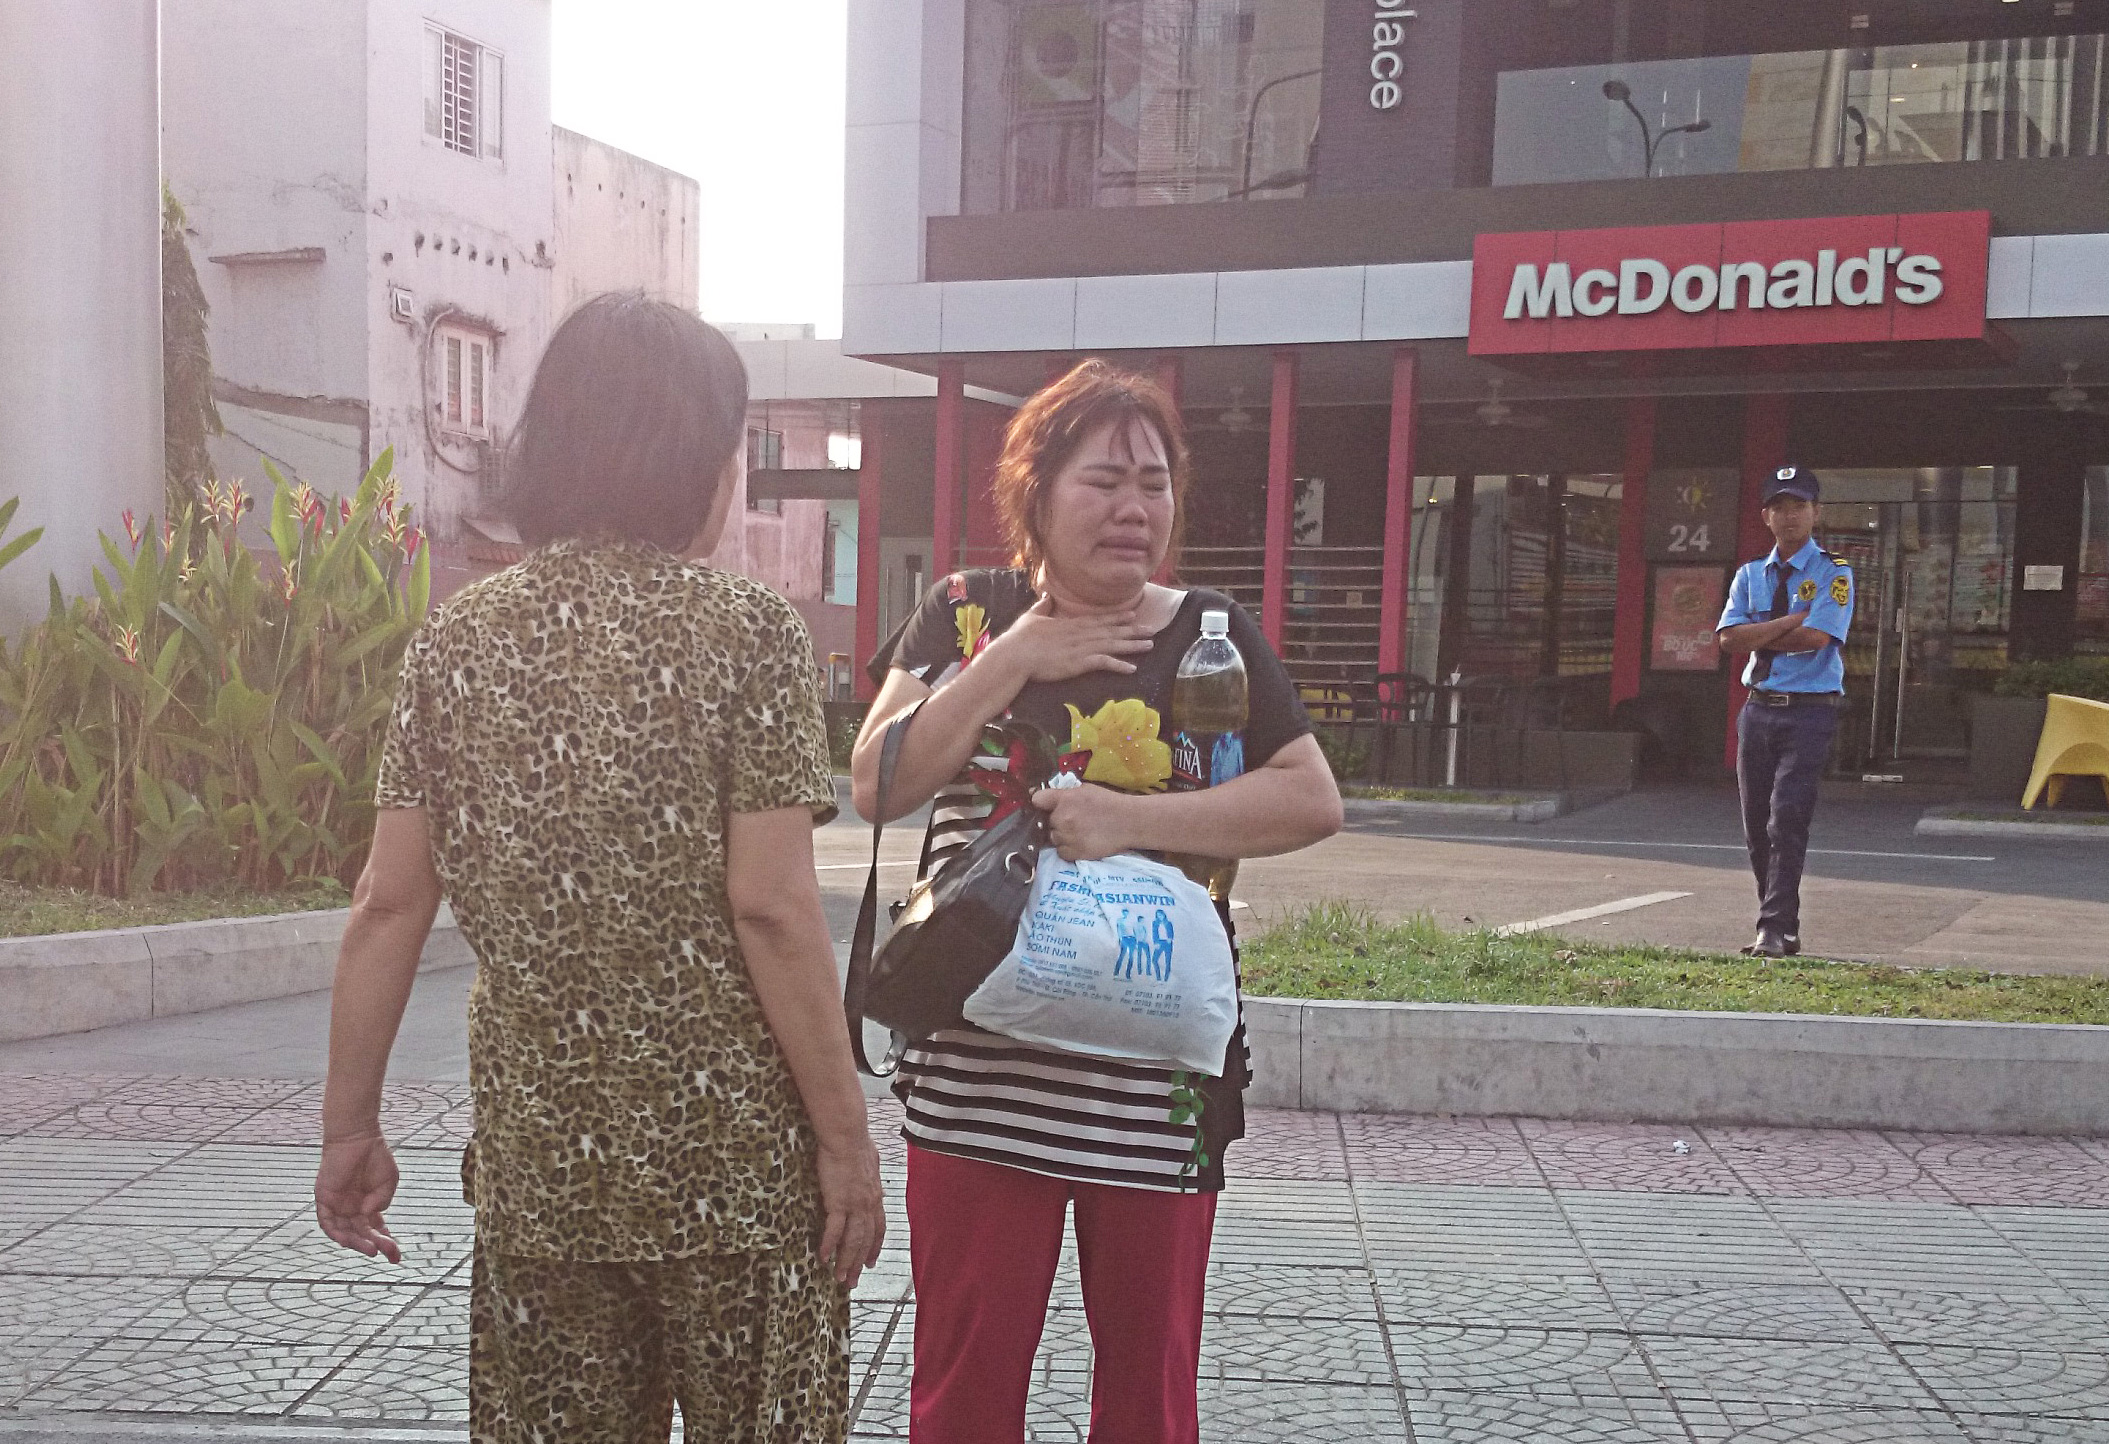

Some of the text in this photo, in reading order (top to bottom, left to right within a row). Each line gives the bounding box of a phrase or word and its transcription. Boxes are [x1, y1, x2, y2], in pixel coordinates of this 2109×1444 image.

[1503, 247, 1944, 319] McDonald's
[1668, 525, 1711, 551] 24
[1095, 893, 1176, 906] ASIANWIN
[1031, 921, 1055, 932] KAKI
[1068, 917, 1095, 928] JEAN
[1046, 935, 1072, 947] THUN
[1052, 947, 1077, 959] NAM
